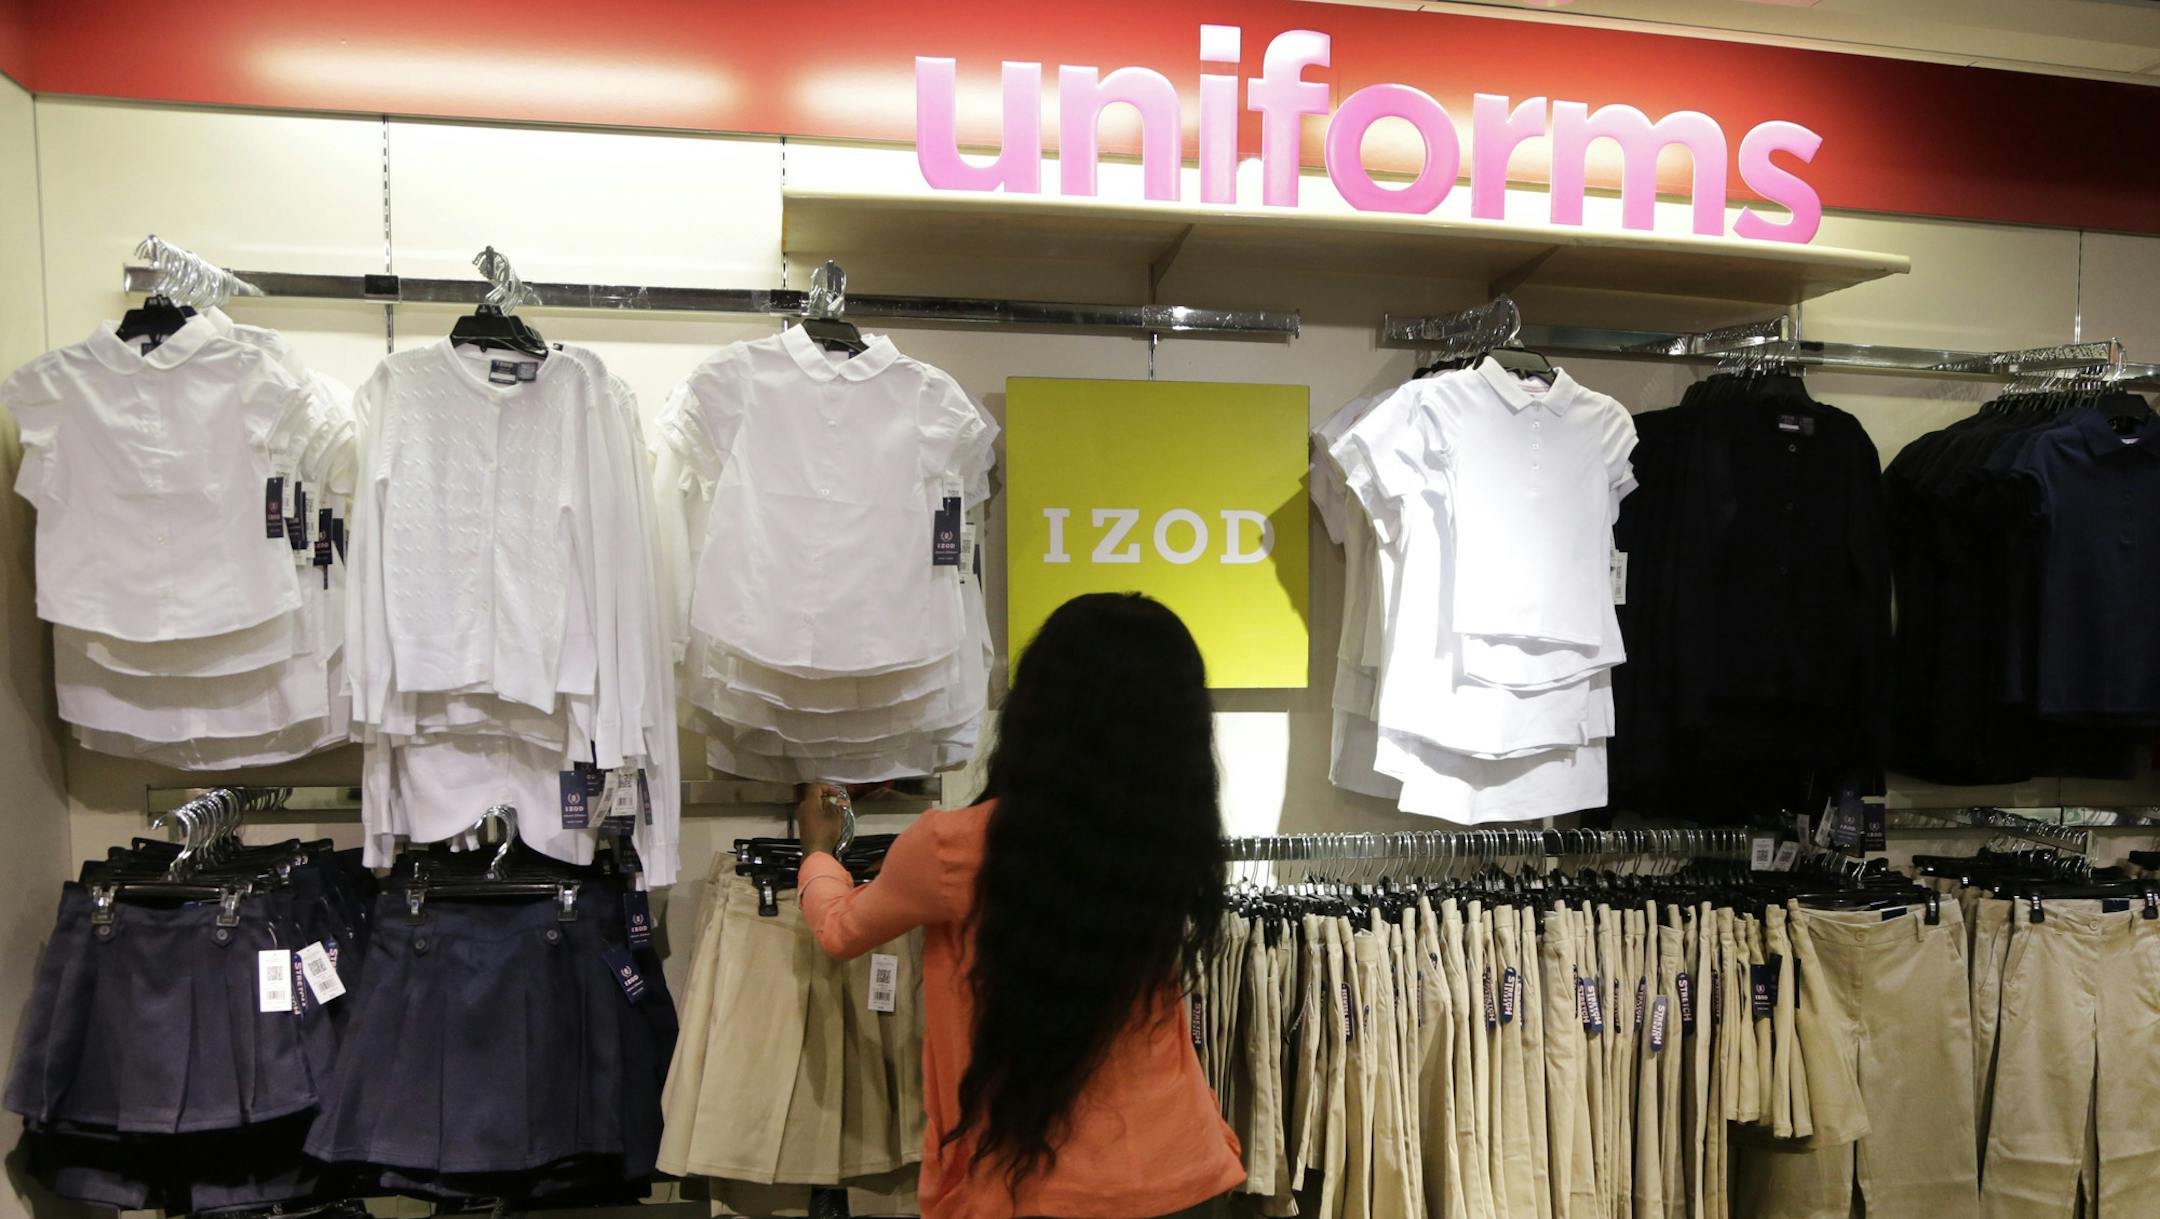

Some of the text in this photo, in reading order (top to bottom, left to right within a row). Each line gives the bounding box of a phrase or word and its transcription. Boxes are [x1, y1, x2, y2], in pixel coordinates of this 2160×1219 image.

[915, 24, 1823, 245] uniforms
[1043, 508, 1275, 564] IZOD
[1505, 975, 1515, 1015] STRETCH
[1588, 985, 1602, 1024] STRETCH
[1679, 980, 1693, 1021] STRETCH
[1653, 1005, 1666, 1044] STRETCH
